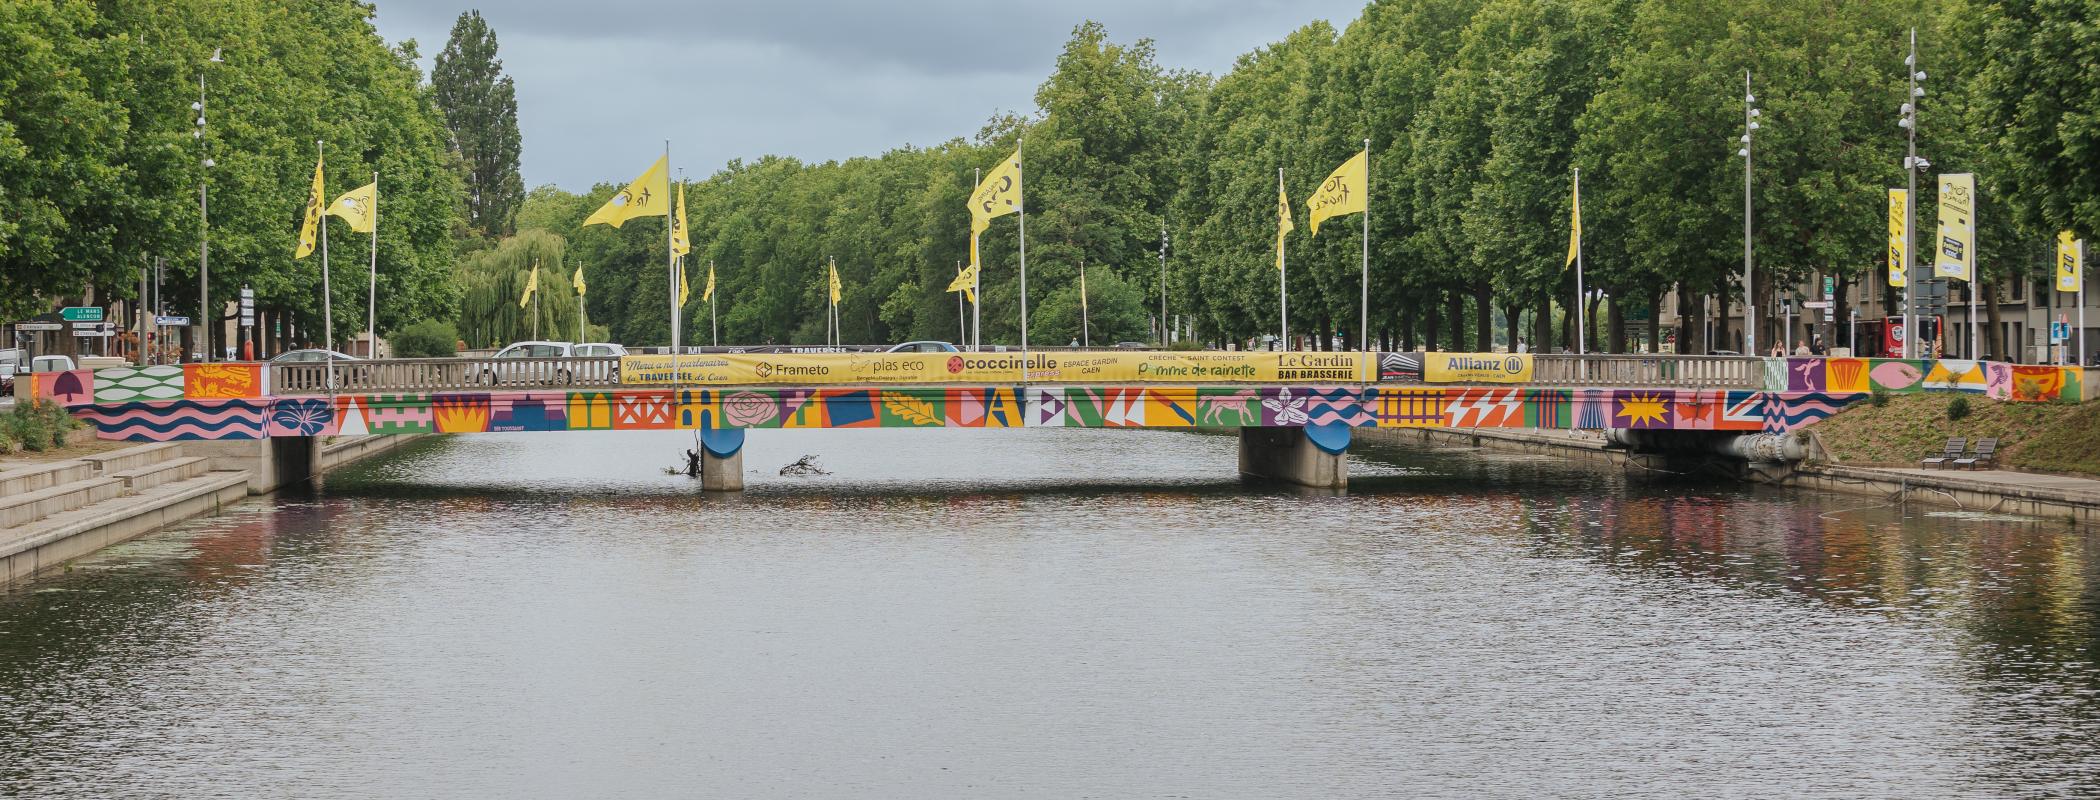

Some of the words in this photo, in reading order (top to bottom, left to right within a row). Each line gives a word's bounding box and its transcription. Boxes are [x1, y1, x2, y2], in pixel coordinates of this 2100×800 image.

[873, 358, 898, 374] plas
[902, 360, 925, 371] eco
[965, 353, 1057, 370] coccinelle
[1063, 360, 1091, 368] ESPACE
[1092, 357, 1118, 367] GARDIN
[1278, 354, 1297, 367] Le
[1301, 354, 1353, 367] Gardin
[1448, 356, 1501, 371] Allianz
[776, 364, 829, 376] Frameto
[1081, 367, 1101, 375] CAEN
[1138, 362, 1188, 376] Pmme
[1191, 362, 1207, 376] de
[1210, 362, 1256, 377] rainette
[1278, 370, 1297, 380] BAR
[1300, 370, 1353, 380] BRASSERIE
[707, 373, 728, 381] Caen
